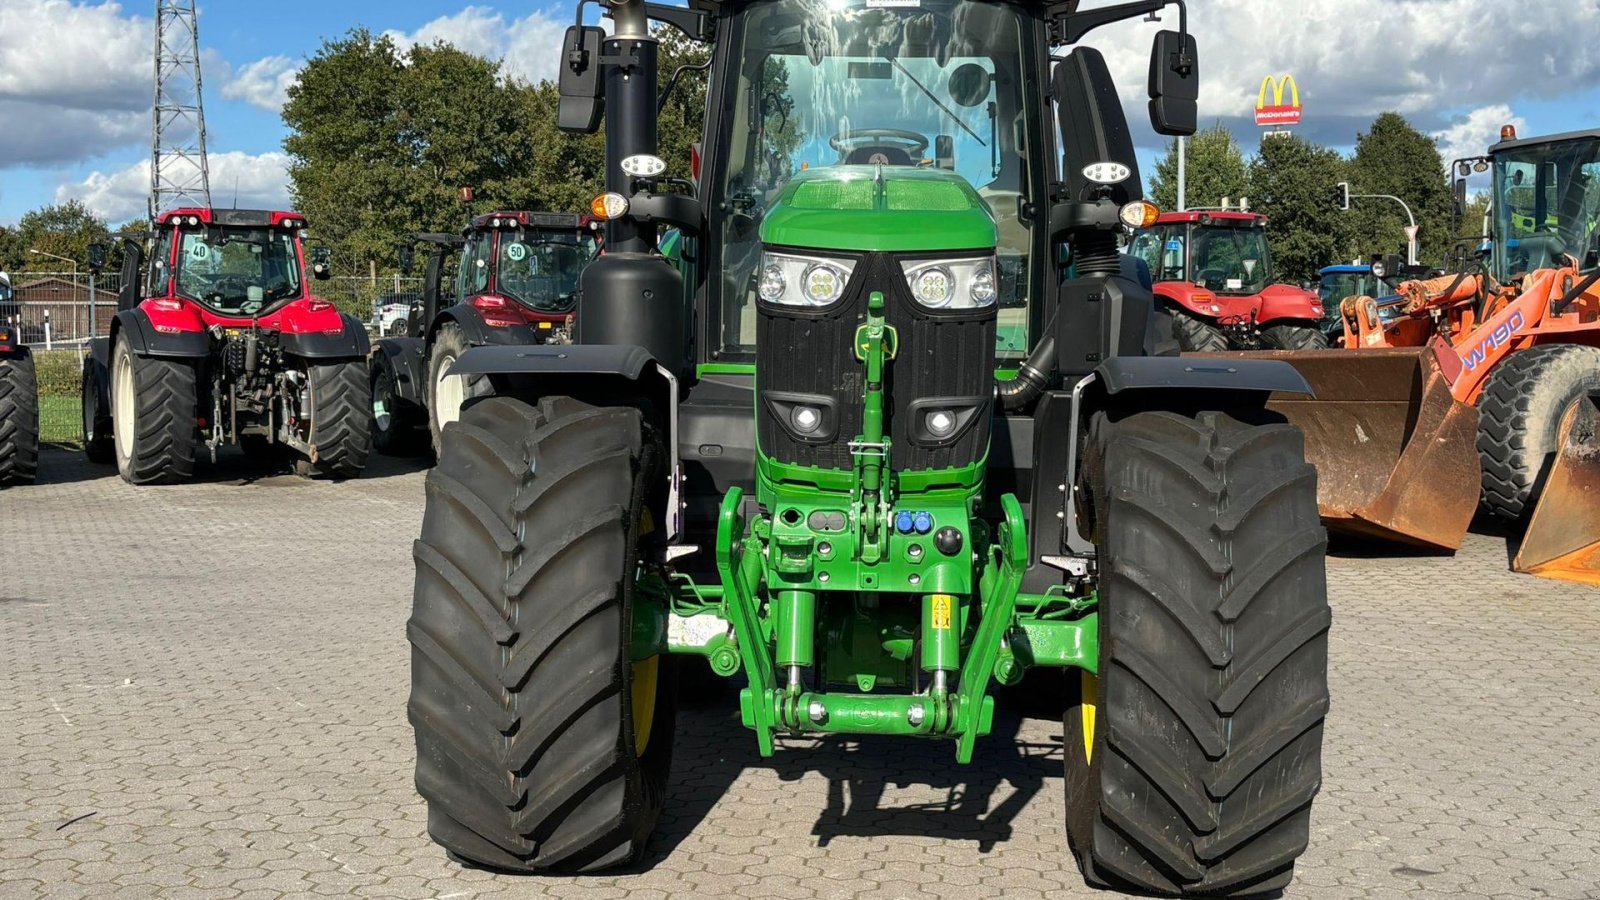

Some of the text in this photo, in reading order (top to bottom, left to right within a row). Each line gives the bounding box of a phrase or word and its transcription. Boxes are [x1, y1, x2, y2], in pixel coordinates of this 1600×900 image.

[193, 245, 205, 257] 40
[511, 246, 522, 257] 50
[1461, 310, 1525, 371] W190
